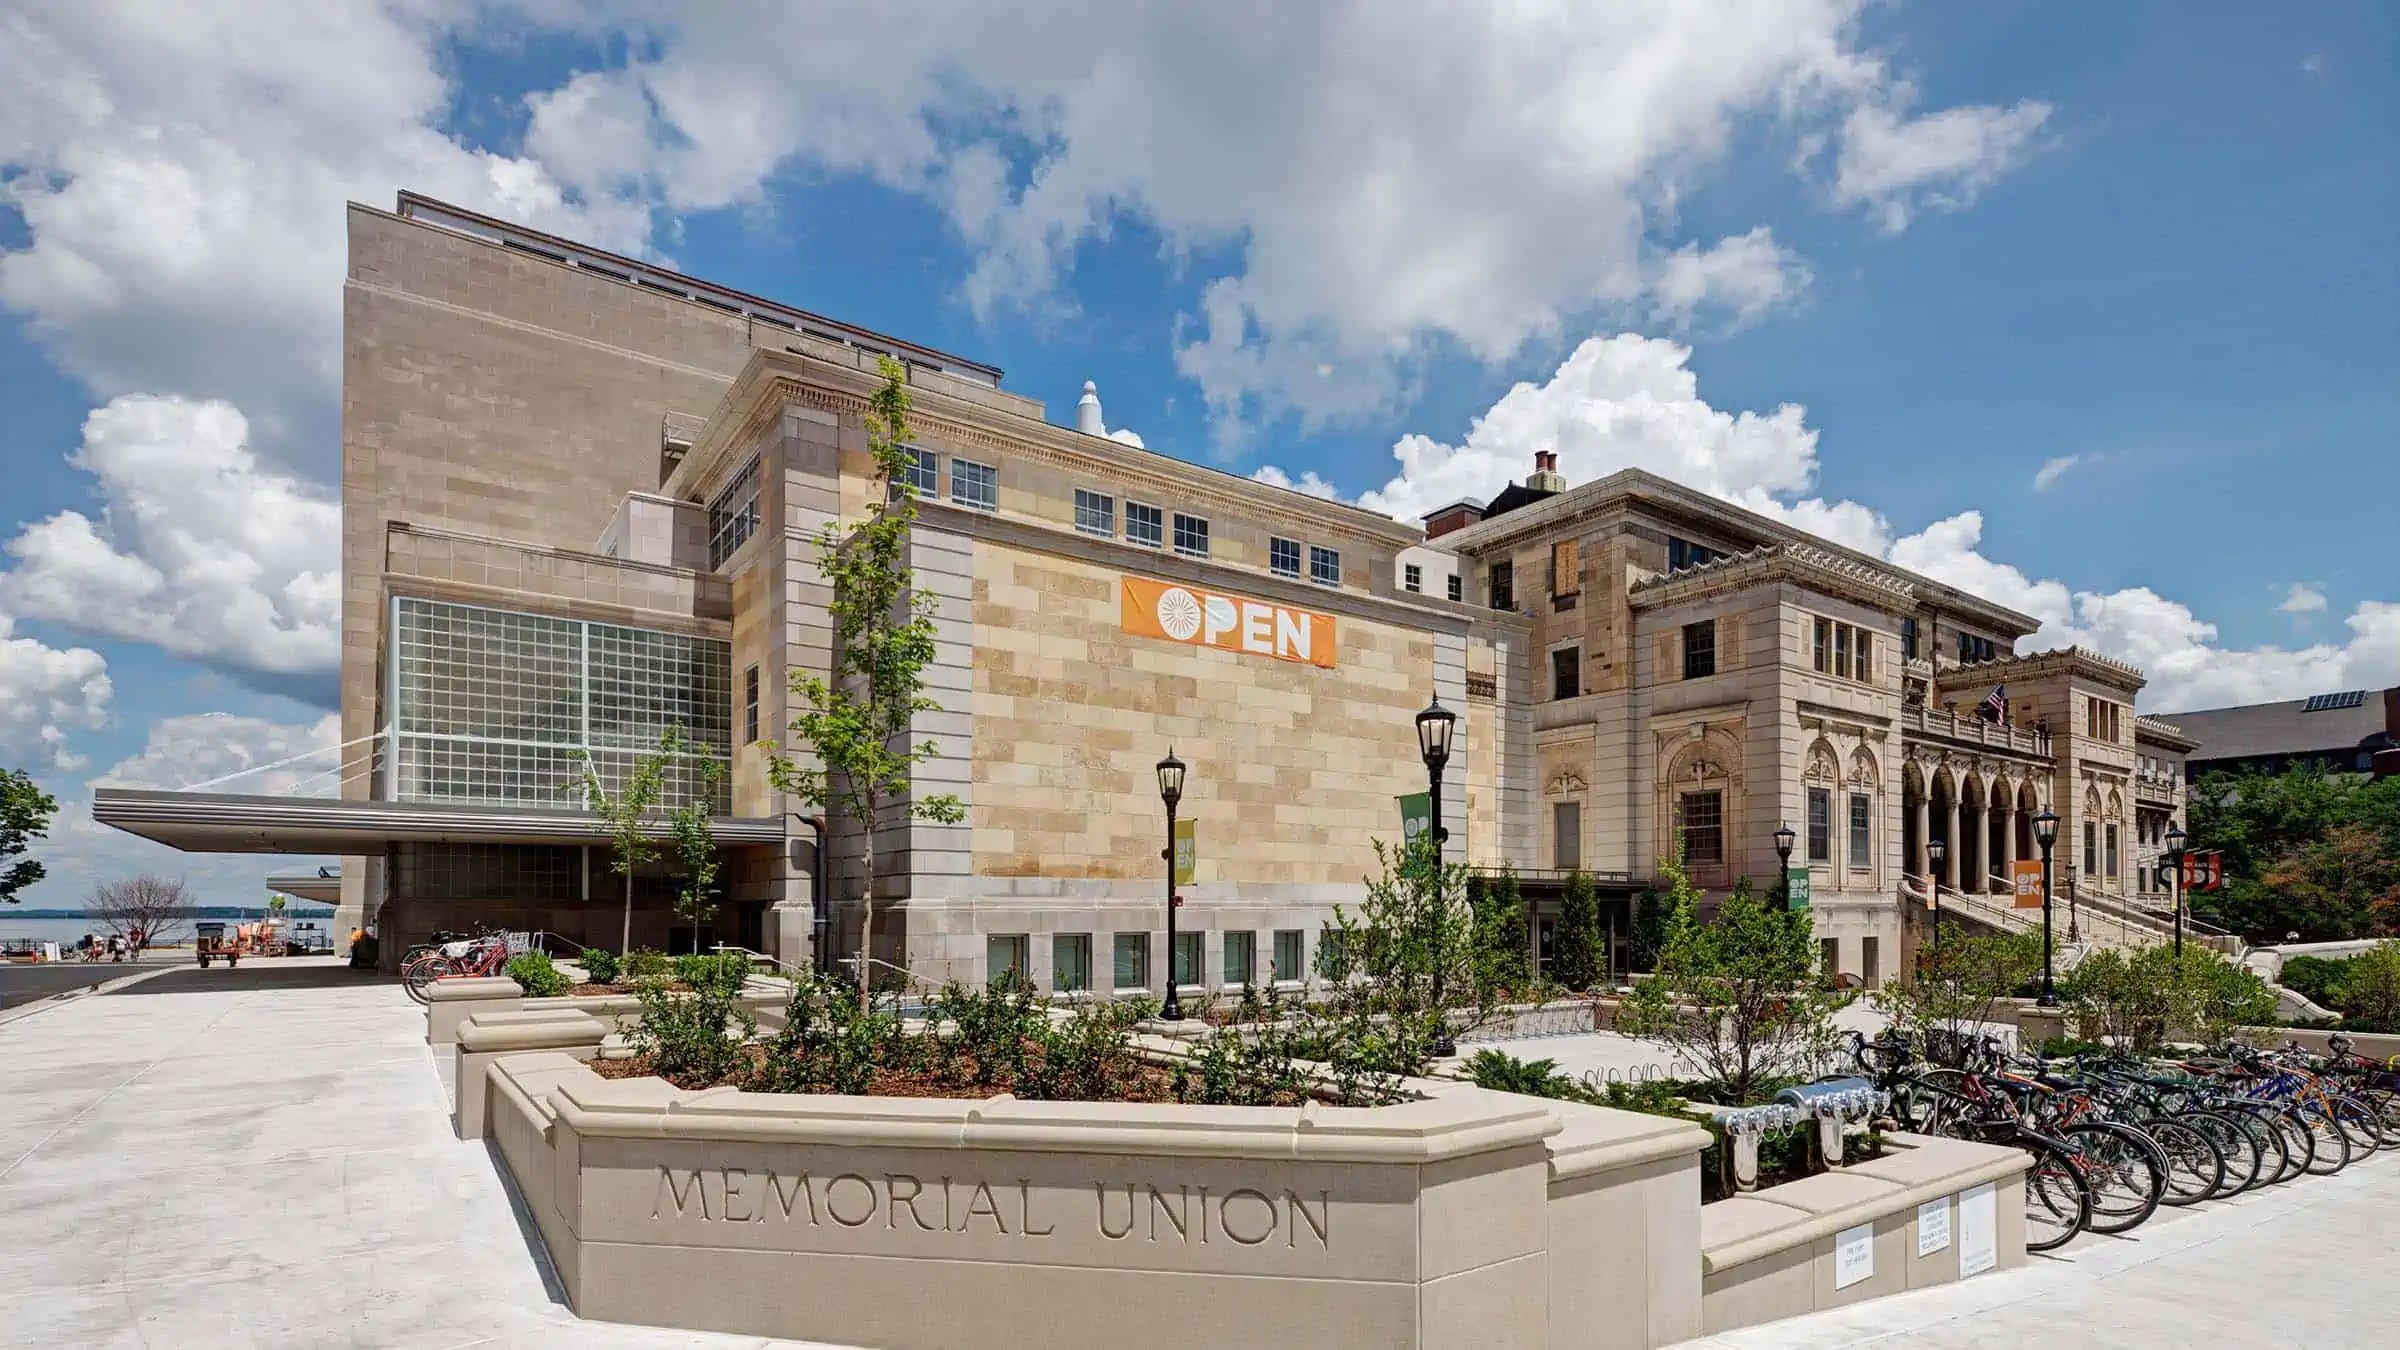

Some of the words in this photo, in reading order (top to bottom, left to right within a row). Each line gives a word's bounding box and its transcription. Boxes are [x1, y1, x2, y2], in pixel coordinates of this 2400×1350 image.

[1157, 587, 1311, 660] OPEN
[1790, 879, 1808, 889] OP
[2016, 873, 2040, 884] OP
[1790, 888, 1808, 898] EN
[2018, 884, 2040, 896] EN
[650, 1163, 1055, 1238] MEMORIAL
[1095, 1179, 1329, 1251] UNION
